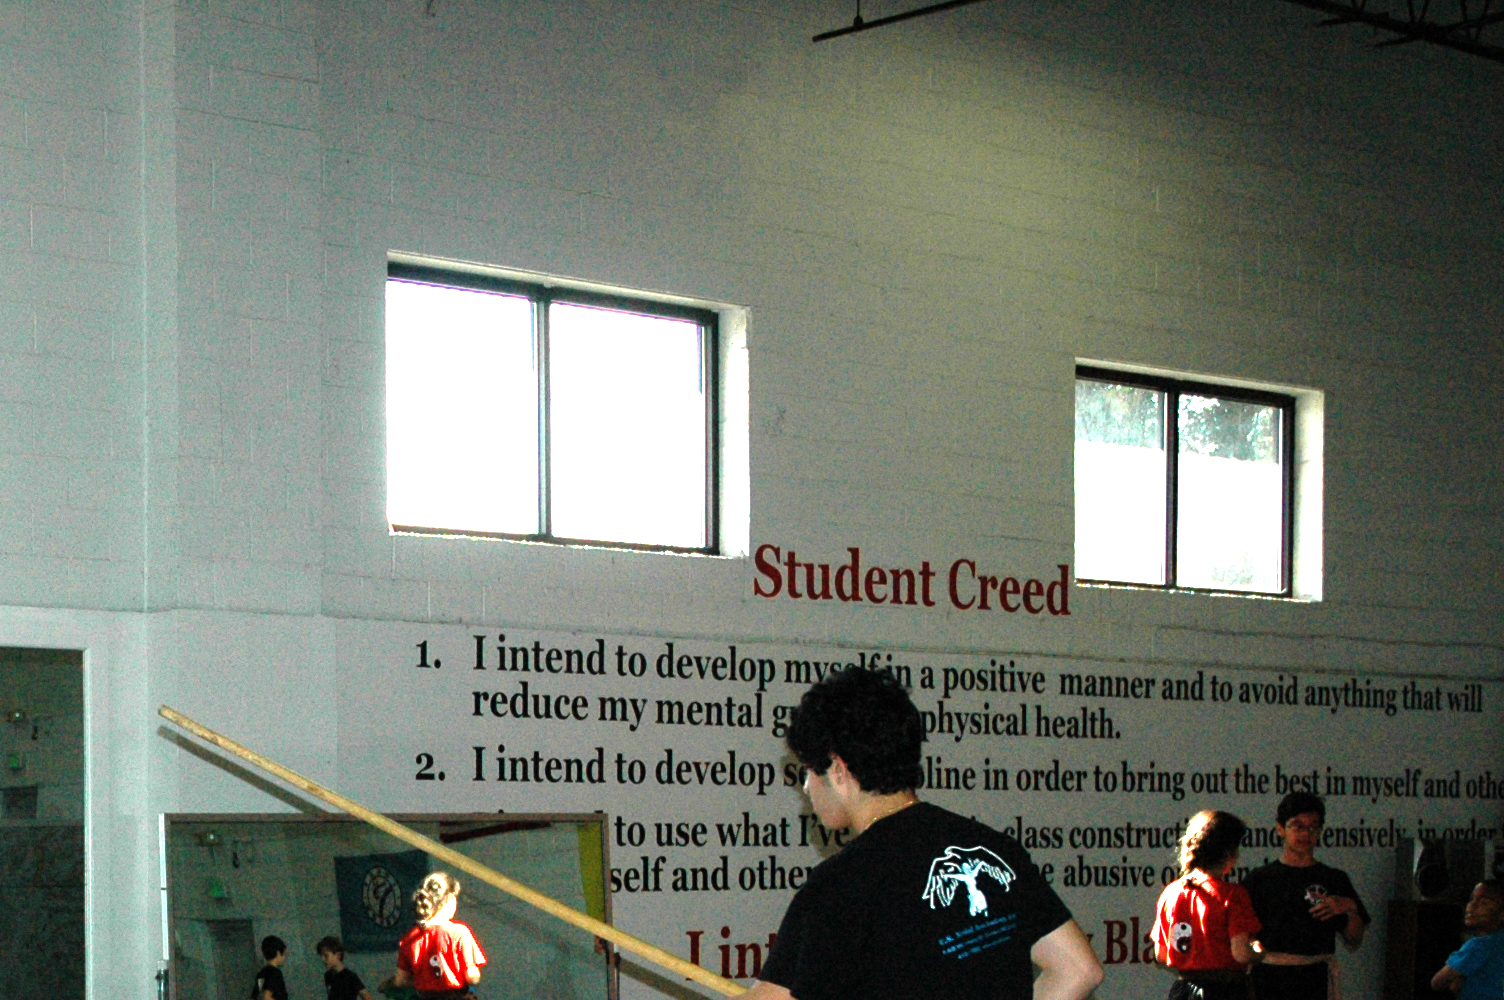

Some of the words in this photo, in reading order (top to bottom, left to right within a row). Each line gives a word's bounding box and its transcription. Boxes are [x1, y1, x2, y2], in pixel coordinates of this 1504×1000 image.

[753, 543, 936, 607] Student
[948, 558, 1072, 616] Creed
[415, 639, 442, 669] 1.
[472, 635, 487, 670] I
[497, 633, 606, 675] intend
[615, 645, 647, 677] to
[656, 642, 776, 692] develop
[920, 667, 935, 690] a
[943, 659, 1046, 699] positive
[1059, 672, 1155, 699] manner
[1161, 671, 1204, 701] and
[1210, 676, 1233, 703] to
[1238, 675, 1298, 706] avoid
[1304, 679, 1397, 716] anything
[1401, 681, 1443, 711] that
[1448, 684, 1483, 713] will
[471, 681, 589, 720] reduce
[598, 696, 648, 731] my
[655, 693, 764, 728] mental
[921, 701, 1027, 742] physical
[1035, 704, 1121, 739] health.
[415, 752, 446, 781] 2.
[472, 746, 486, 781] I
[496, 744, 606, 783] intend
[615, 753, 647, 784] to
[655, 749, 775, 795] develop
[983, 758, 1008, 791] in
[1016, 760, 1088, 792] order
[1093, 764, 1118, 792] to
[1121, 761, 1185, 801] bring
[1191, 766, 1229, 794] out
[1234, 763, 1270, 794] the
[1275, 765, 1320, 795] best
[1326, 767, 1347, 796] in
[1352, 769, 1422, 803] myself
[1424, 770, 1460, 799] and
[614, 816, 646, 847] to
[655, 821, 708, 847] use
[716, 812, 791, 847] what
[672, 856, 730, 891] and
[1064, 855, 1155, 887] abusive
